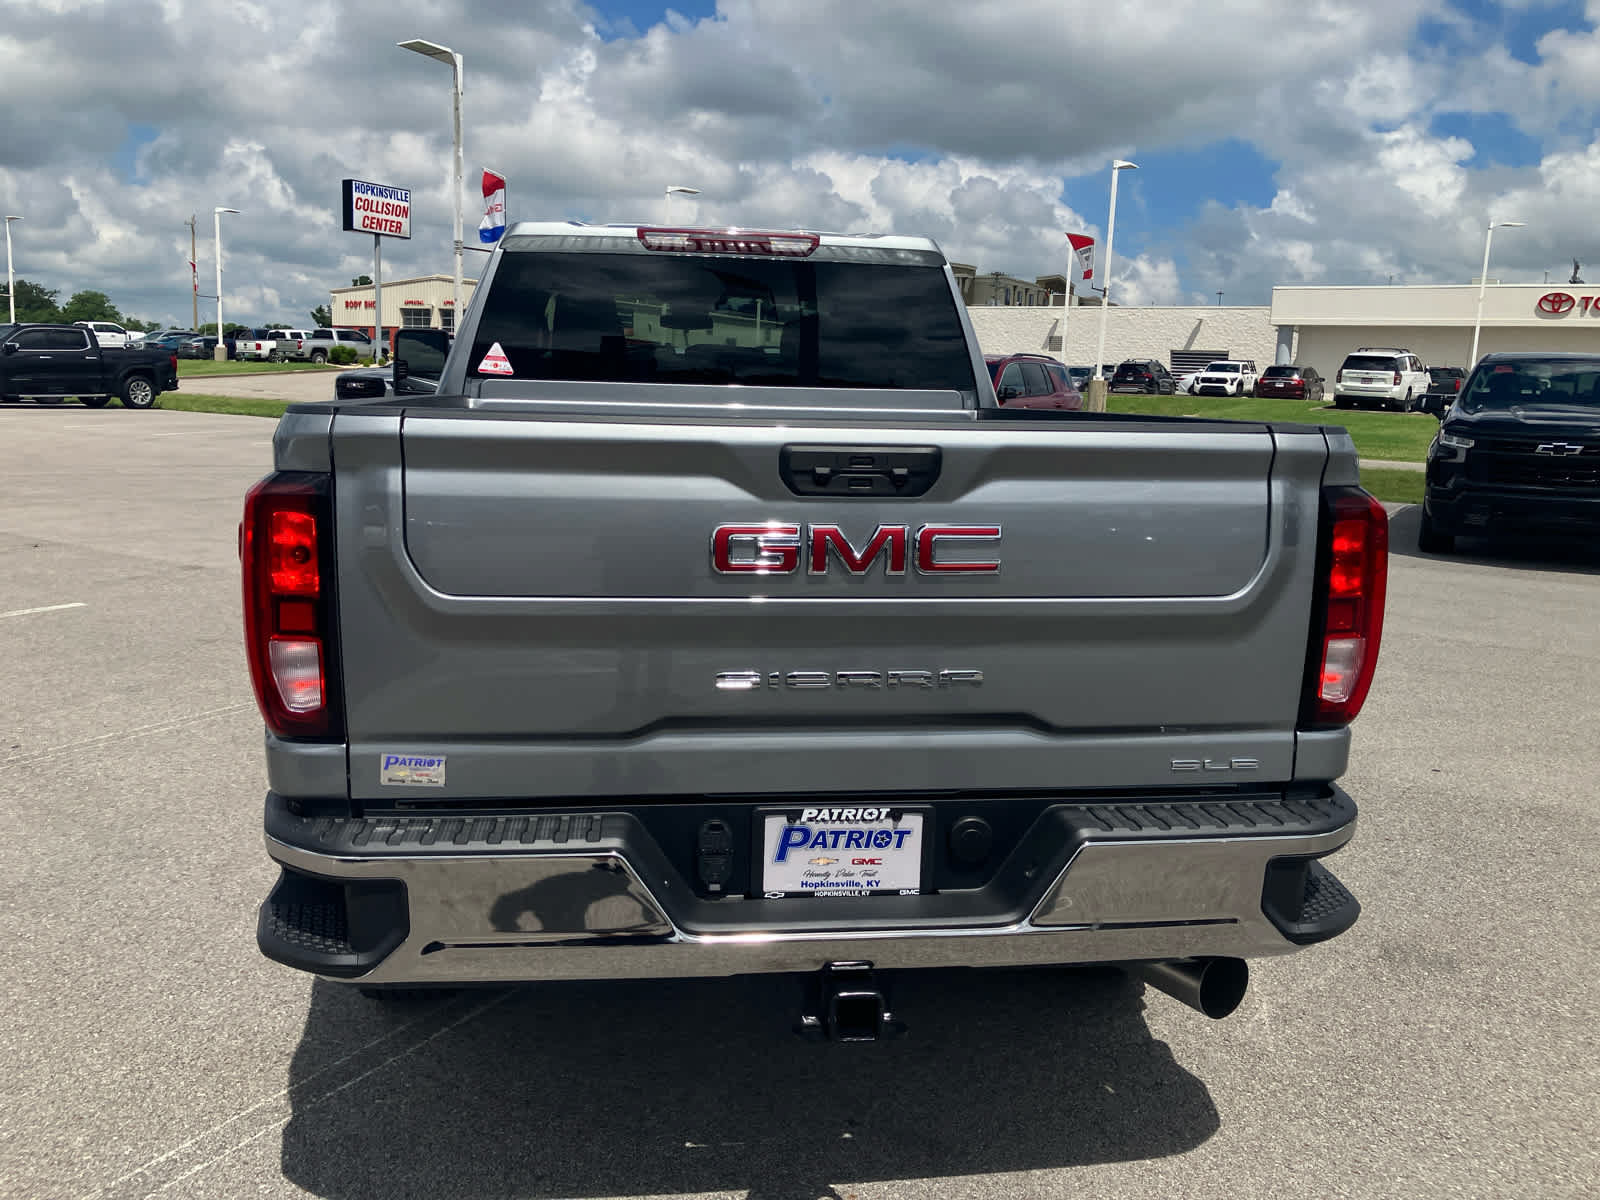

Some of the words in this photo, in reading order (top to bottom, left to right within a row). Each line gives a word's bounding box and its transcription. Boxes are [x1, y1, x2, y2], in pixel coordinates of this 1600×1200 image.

[354, 182, 409, 203] HOPKINSVILLE
[355, 197, 409, 219] COLLISION
[362, 215, 403, 234] CENTER
[345, 300, 362, 310] BODY
[710, 522, 1002, 576] GMC
[715, 669, 984, 690] SIERRA
[384, 754, 444, 770] PATRIOT
[1171, 758, 1259, 770] SLE
[800, 808, 890, 822] PATRIOT
[773, 825, 912, 864] PATRIOT
[800, 880, 864, 889] Hopkinsville,
[866, 879, 881, 888] KY
